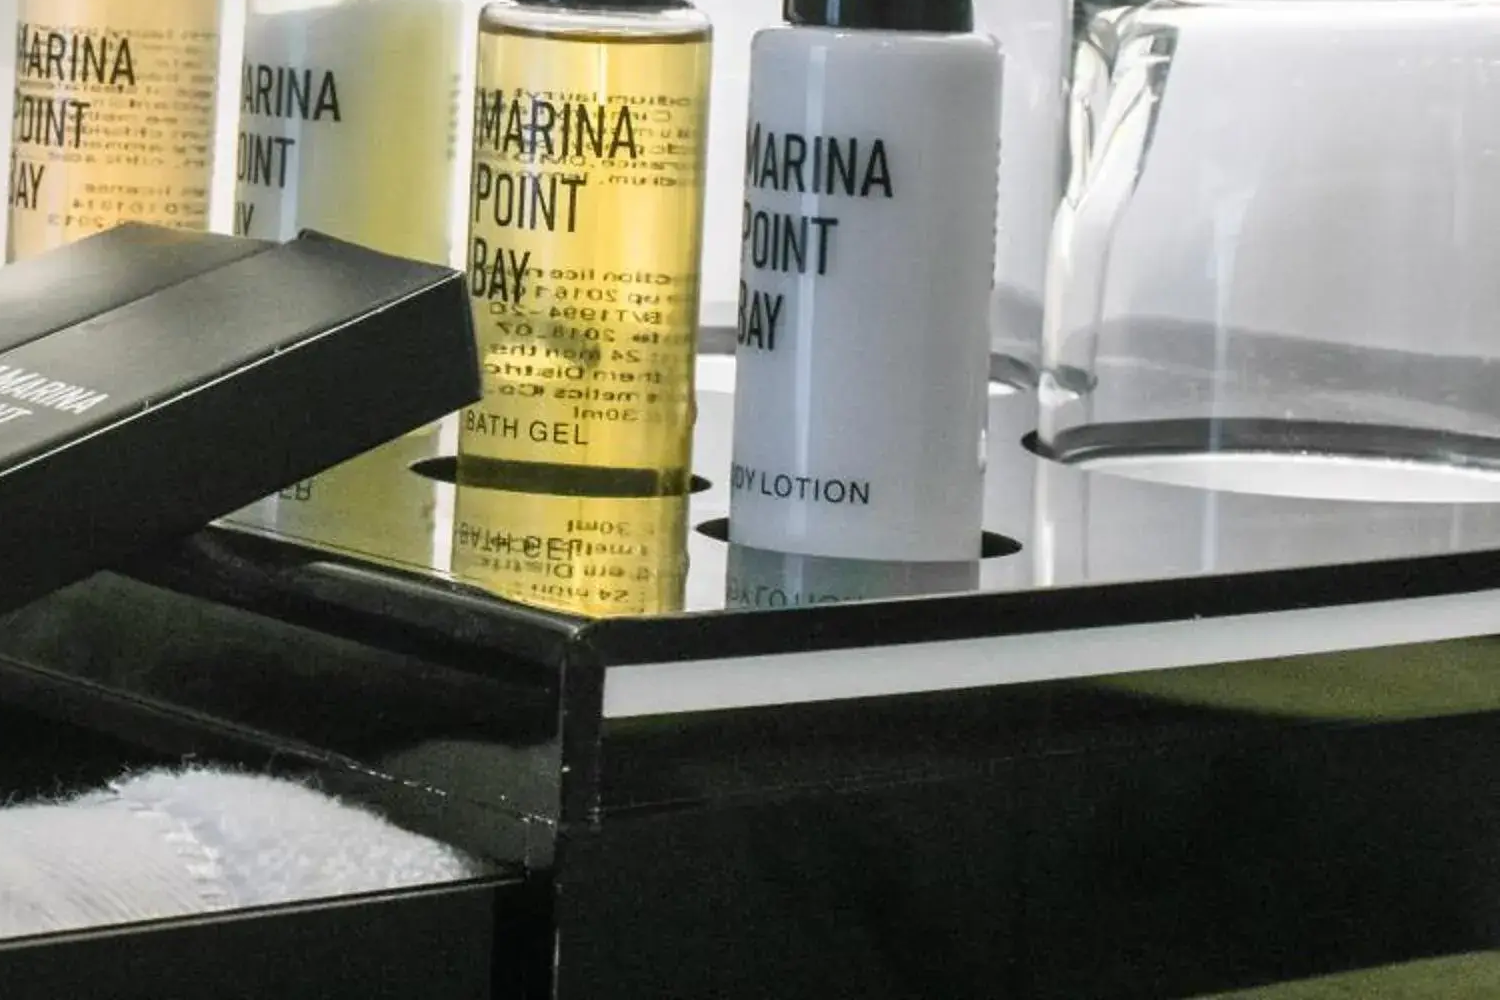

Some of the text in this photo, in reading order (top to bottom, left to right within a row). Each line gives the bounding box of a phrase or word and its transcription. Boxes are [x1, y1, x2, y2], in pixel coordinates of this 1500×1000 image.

[241, 63, 341, 122] ARINA
[477, 87, 637, 159] MARINA
[473, 162, 587, 232] POINT
[472, 236, 531, 305] BAY
[465, 408, 589, 446] BATH GEL
[761, 472, 871, 505] LOTION
